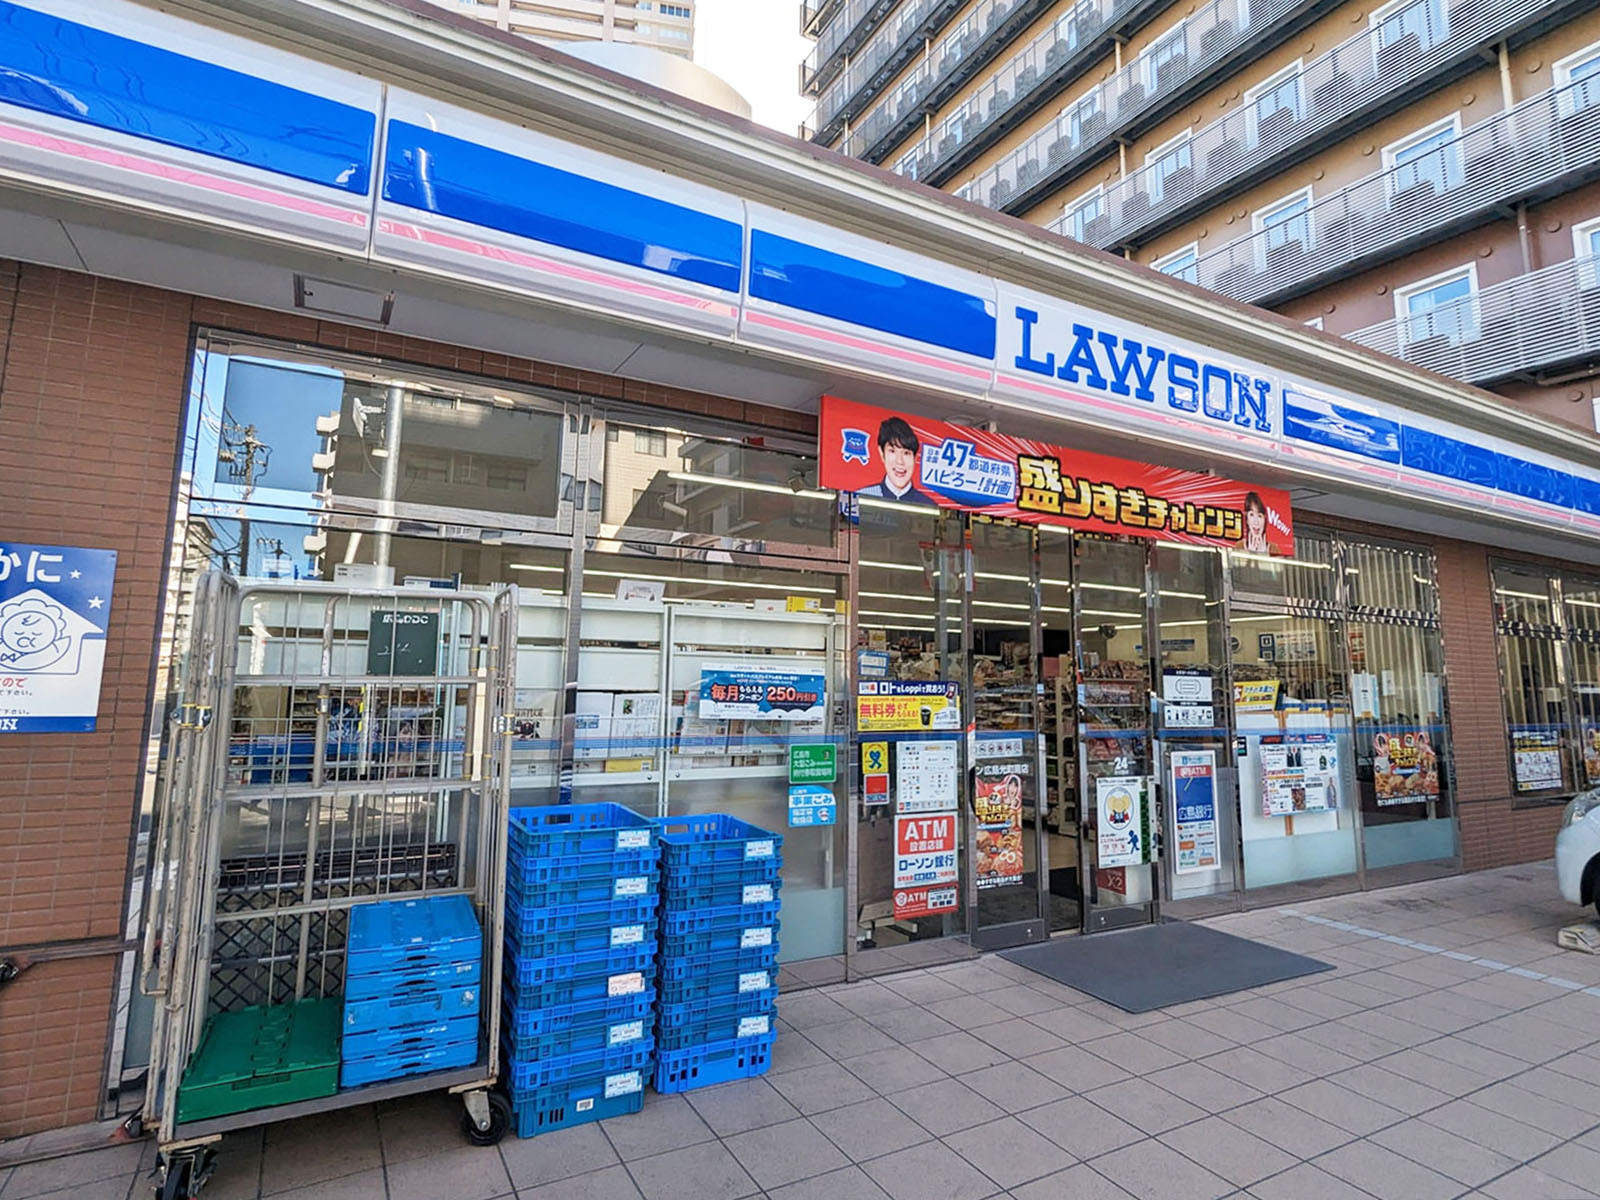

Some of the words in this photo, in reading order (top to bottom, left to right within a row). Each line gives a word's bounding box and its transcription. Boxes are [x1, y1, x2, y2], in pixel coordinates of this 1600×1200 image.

[1014, 306, 1272, 433] LAWSON
[1017, 454, 1243, 541] 盛りすぎチャレンジ
[0, 676, 28, 688] ので
[711, 684, 739, 701] 毎月
[860, 703, 896, 718] 無料券
[1114, 757, 1129, 770] 24
[1178, 804, 1213, 820] 広島銀行
[905, 820, 948, 841] ATM
[898, 855, 954, 872] ローソン銀行
[908, 891, 927, 903] ATM
